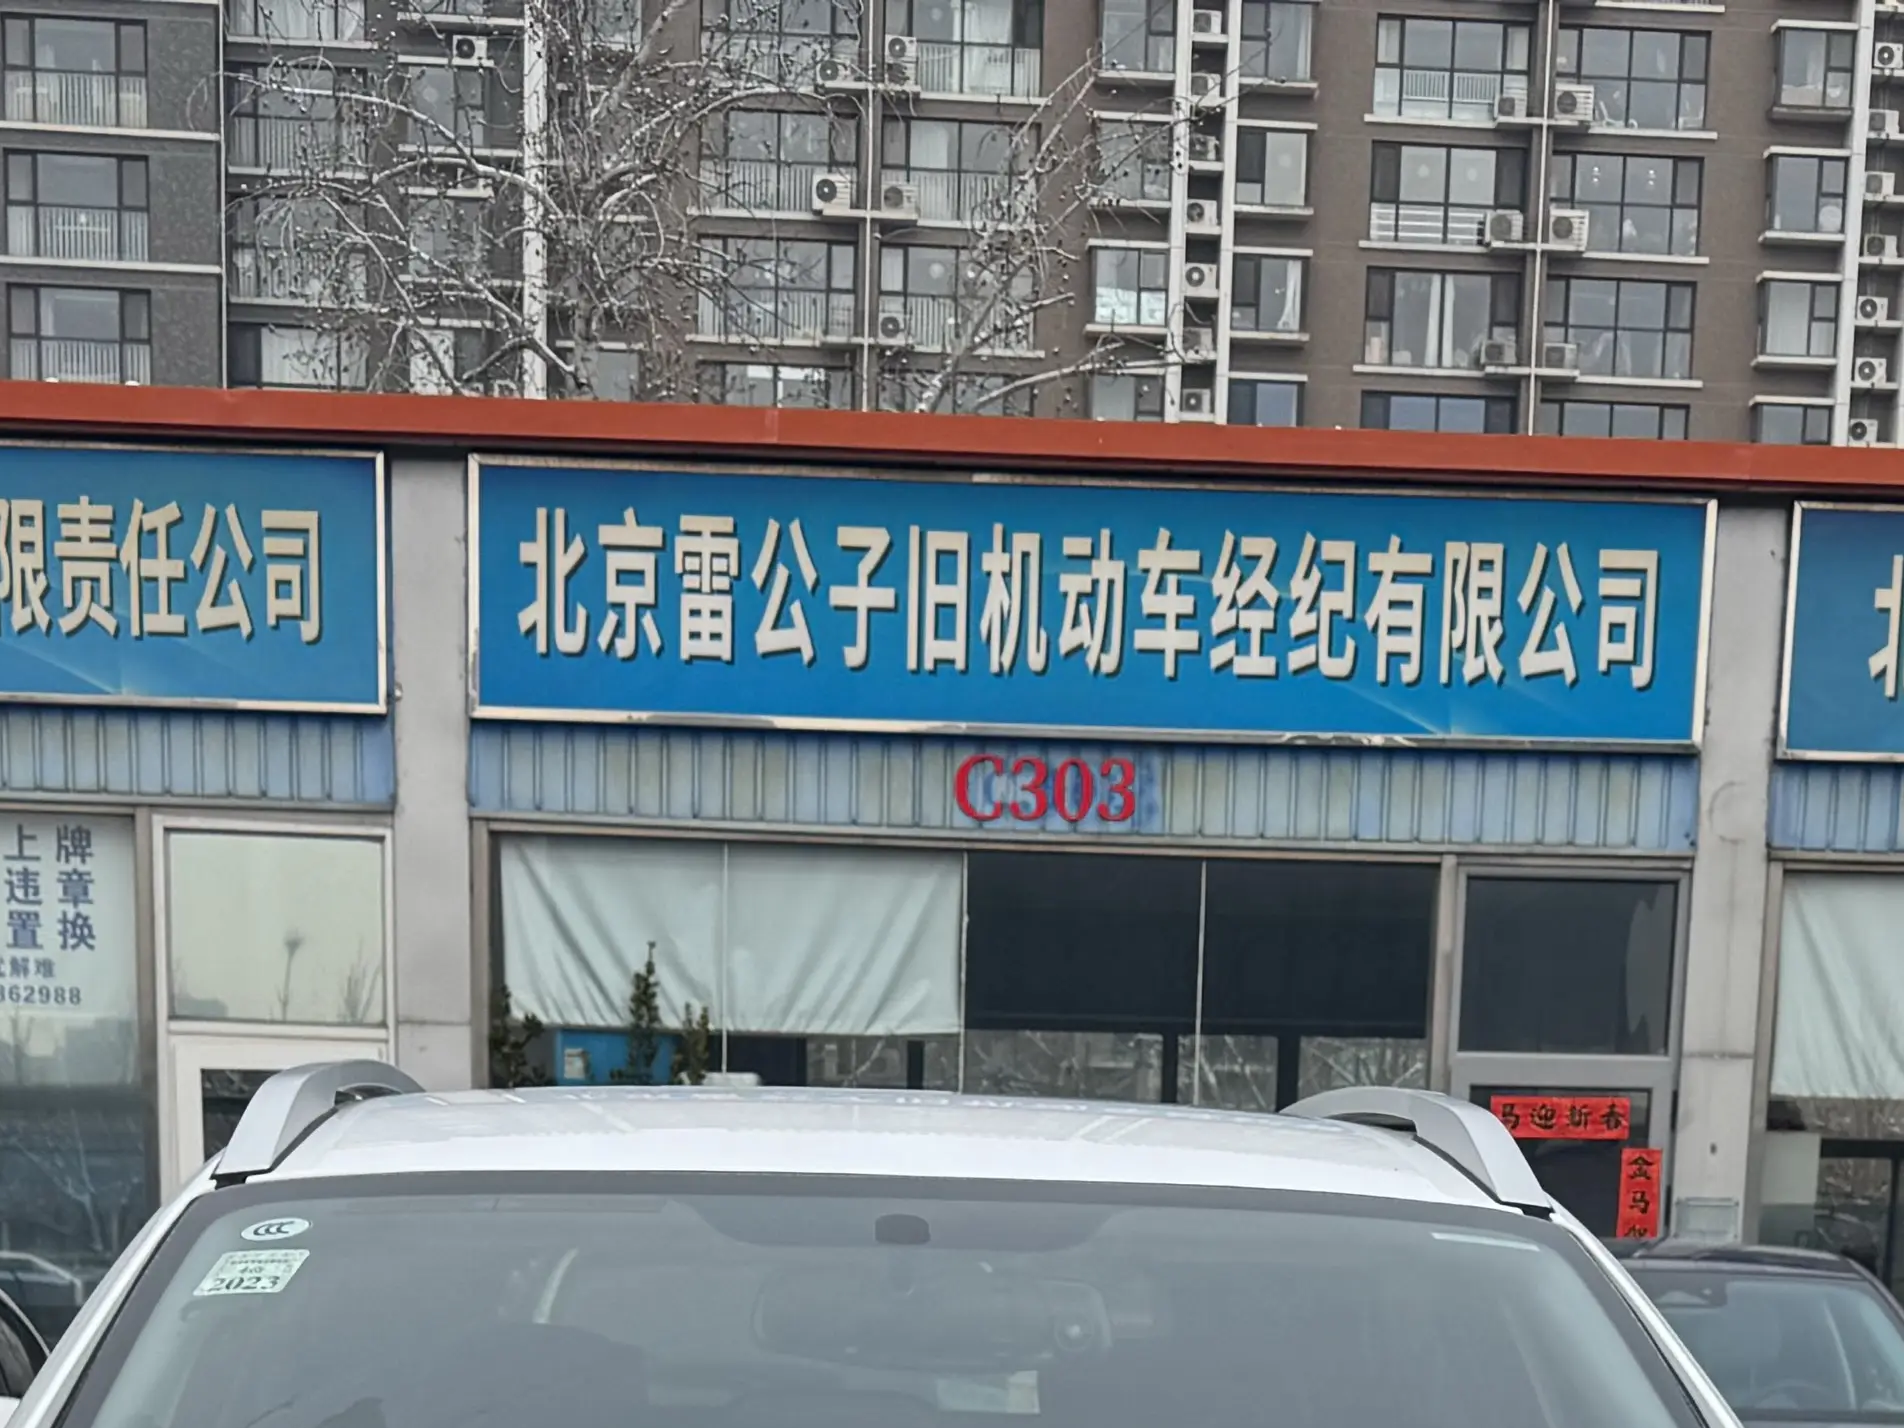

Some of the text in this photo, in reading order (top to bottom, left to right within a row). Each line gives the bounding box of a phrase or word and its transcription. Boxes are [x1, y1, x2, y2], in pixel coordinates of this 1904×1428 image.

[517, 506, 1660, 689] 北京雷公子旧机动车经纪有限公司
[953, 754, 1137, 822] C303
[4, 824, 93, 865] 上牌
[4, 867, 95, 908] 违章
[6, 910, 96, 950] 置换
[1499, 1103, 1628, 1131] 马迎新春
[207, 1275, 281, 1293] 2023
